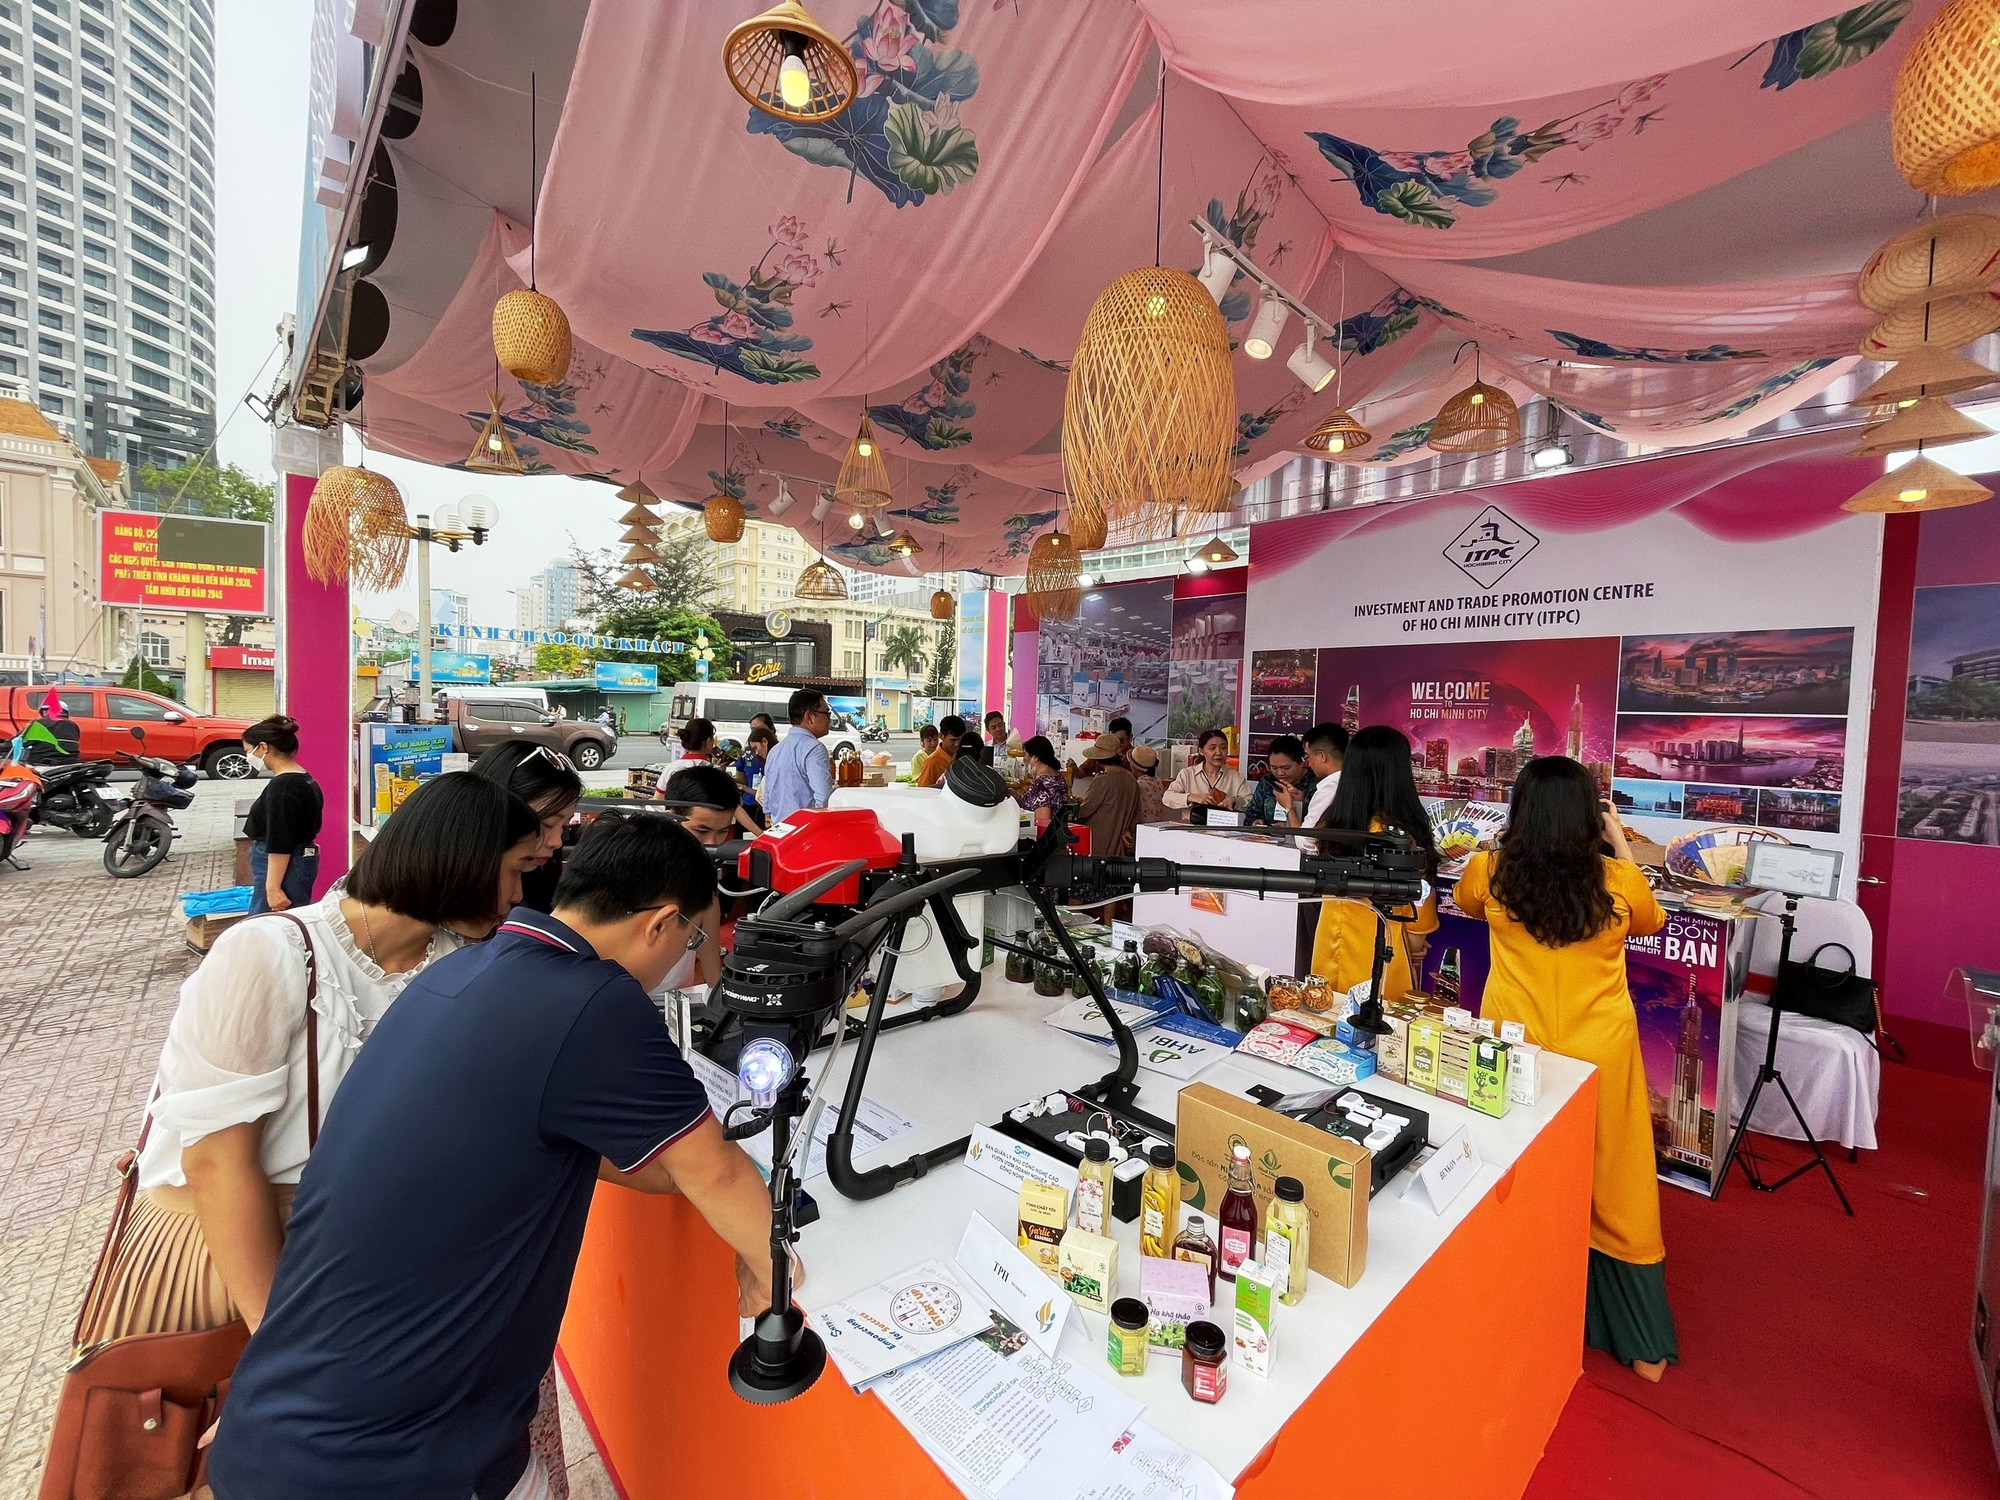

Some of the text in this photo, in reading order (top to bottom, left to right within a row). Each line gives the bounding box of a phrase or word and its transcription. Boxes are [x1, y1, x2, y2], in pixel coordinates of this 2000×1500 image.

[1464, 546, 1514, 562] ITPC
[208, 588, 223, 599] 2045
[1354, 583, 1654, 617] INVESTMENT AND TRADE PROMOTION CENTRE
[1402, 609, 1581, 632] OF HO CHI MINH CITY (ITPC)
[620, 635, 685, 654] KHÁCH
[242, 654, 275, 666] Imar
[747, 662, 782, 682] Guru
[1411, 682, 1490, 699] WELCOME
[1410, 708, 1488, 719] HO CHI MINH CITY
[1692, 918, 1718, 927] MINH
[1667, 923, 1717, 942] ĐÓN
[1647, 948, 1661, 956] CITY
[1665, 936, 1717, 968] BẠN
[1149, 1035, 1207, 1054] AHBI
[985, 1143, 993, 1151] BAN
[1012, 1156, 1021, 1164] KHU
[1022, 1160, 1035, 1172] CÔNG
[1048, 1174, 1059, 1183] CAO
[1000, 1164, 1012, 1175] CÔNG
[1015, 1164, 1030, 1176] DOANH
[1028, 1225, 1050, 1238] Garlic
[911, 1288, 944, 1328] START UP
[1151, 1308, 1191, 1320] Hạ khô thảo
[846, 1318, 896, 1350] Empowering
[859, 1311, 903, 1341] for Success
